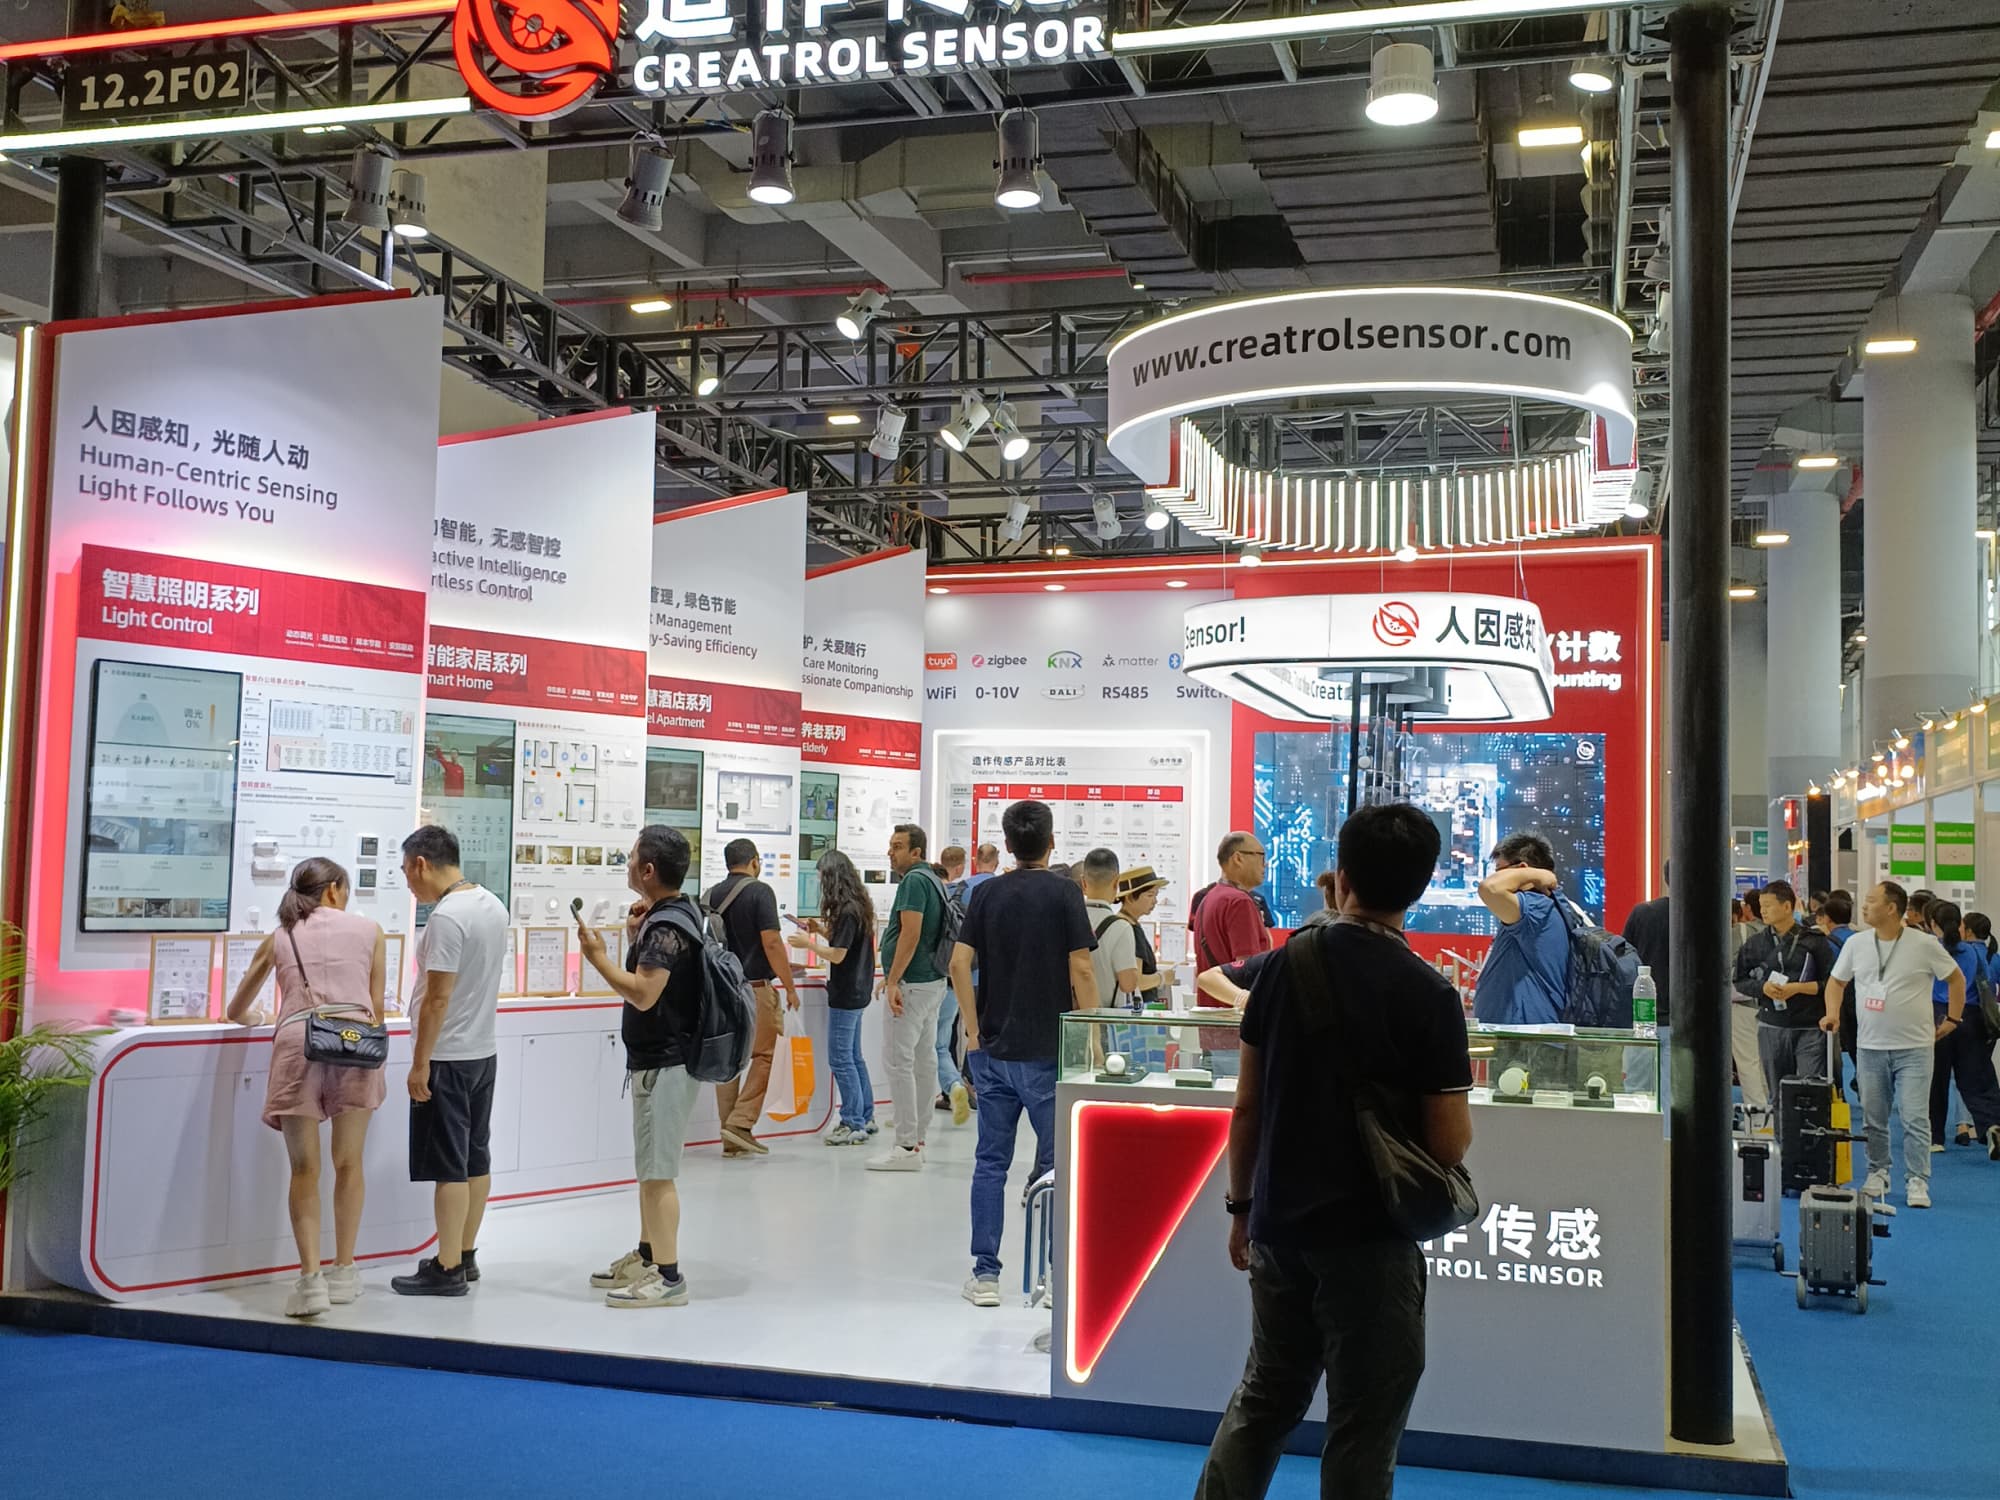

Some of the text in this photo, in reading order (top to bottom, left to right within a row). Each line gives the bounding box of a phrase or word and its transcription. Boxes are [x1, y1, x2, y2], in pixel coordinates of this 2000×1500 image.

[634, 35, 888, 93] CREATROL
[903, 16, 1103, 70] SENSOR
[79, 62, 241, 111] 12.2F02
[1132, 317, 1572, 388] www.creatrolsensor.com
[79, 443, 339, 510] Human-Centric Sensing
[78, 474, 275, 524] Light Follows You
[479, 555, 568, 584] Intelligence
[101, 567, 261, 616] 智慧照明系列
[478, 579, 534, 602] Control
[101, 606, 214, 635] Light Control
[656, 613, 732, 636] Management
[1435, 605, 1536, 654] 人因感知
[1185, 616, 1245, 650] Sensor!
[705, 639, 758, 660] Efficiency
[1546, 630, 1622, 662] 计数
[802, 656, 879, 680] Care Monitoring
[927, 655, 954, 668] tuya
[987, 654, 1028, 669] zigbee
[1047, 657, 1083, 669] KNX
[1118, 656, 1159, 667] matter
[456, 674, 494, 690] Home
[844, 678, 914, 700] Companionship
[926, 685, 957, 700] WiFi
[975, 686, 1020, 699] 0-10V
[1049, 688, 1077, 696] DALI
[1102, 686, 1149, 699] RS485
[185, 720, 200, 729] 0%
[656, 716, 706, 729] Apartment
[801, 721, 846, 742] 养老系列
[801, 742, 829, 756] Elderly
[972, 756, 1067, 767] 造作传感产品对比表
[1497, 1262, 1603, 1287] SENSOR
